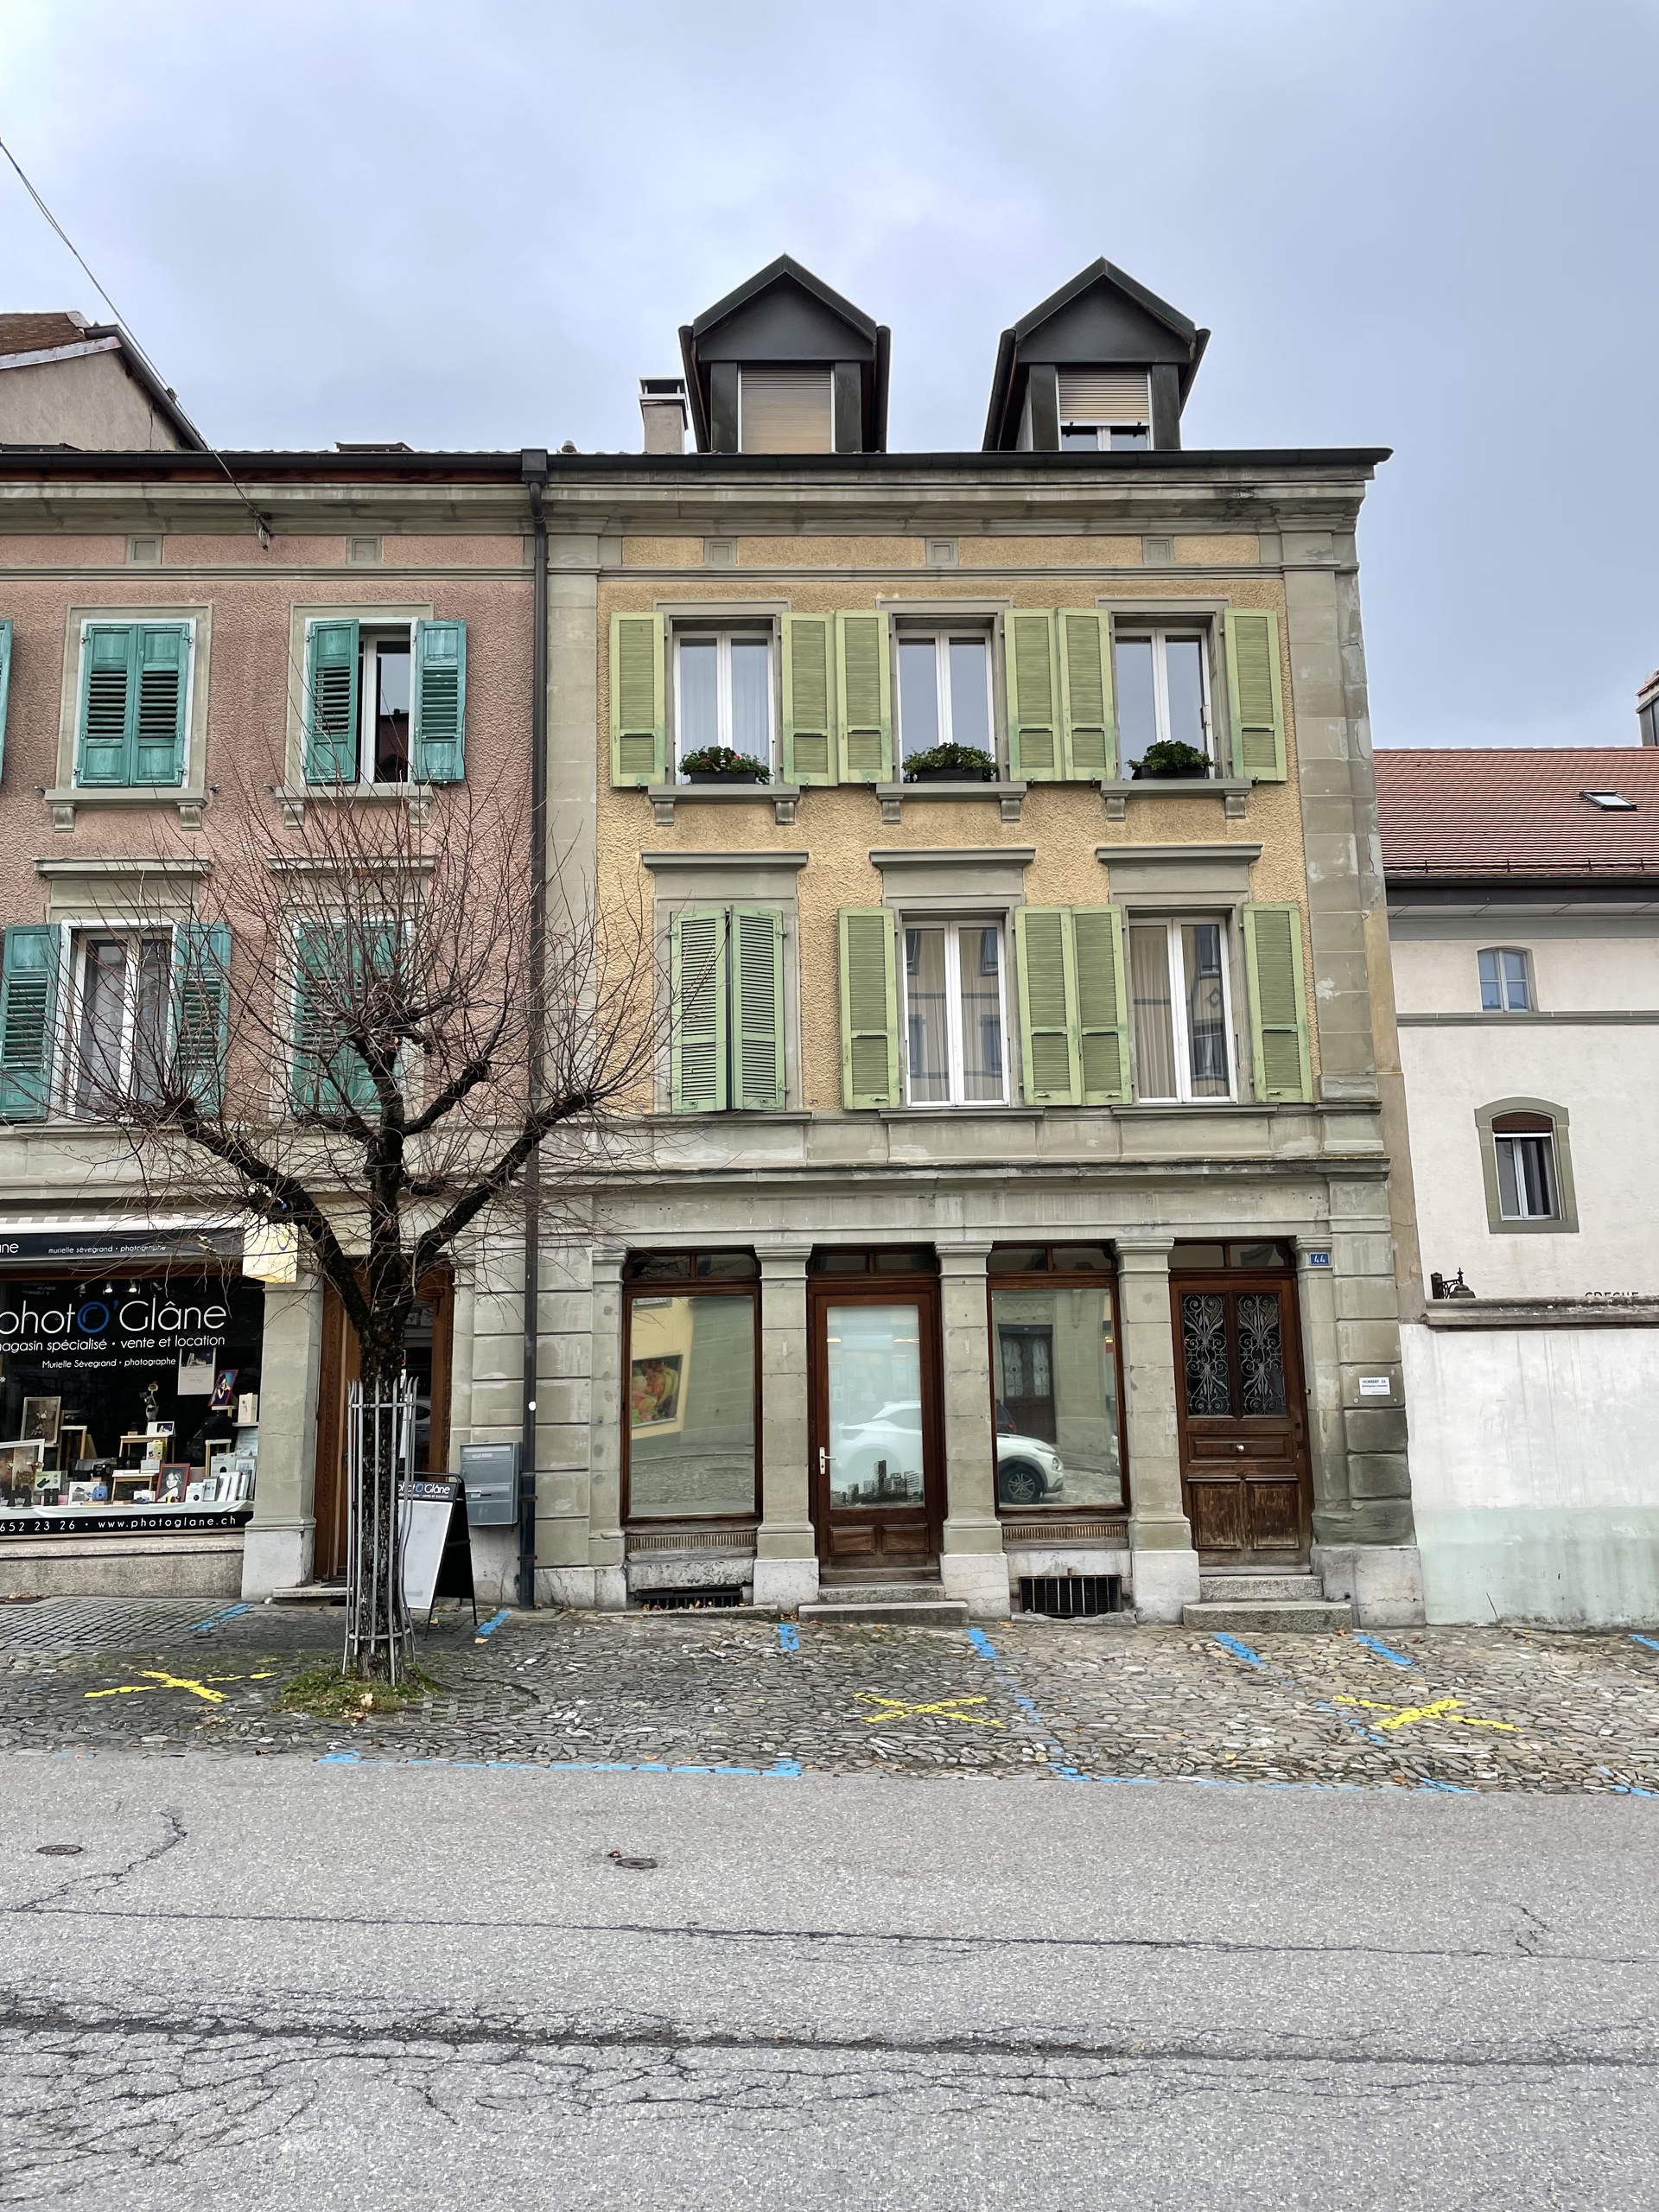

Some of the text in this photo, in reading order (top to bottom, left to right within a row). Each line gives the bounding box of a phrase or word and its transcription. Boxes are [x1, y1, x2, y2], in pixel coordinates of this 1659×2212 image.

[1313, 1255, 1325, 1263] 44
[0, 1335, 226, 1353] agasin spécialisé vente et location
[41, 1360, 73, 1369] Murielle
[124, 1357, 176, 1368] photographe
[0, 1516, 237, 1532] 652 23 26 www.photoglane.ch
